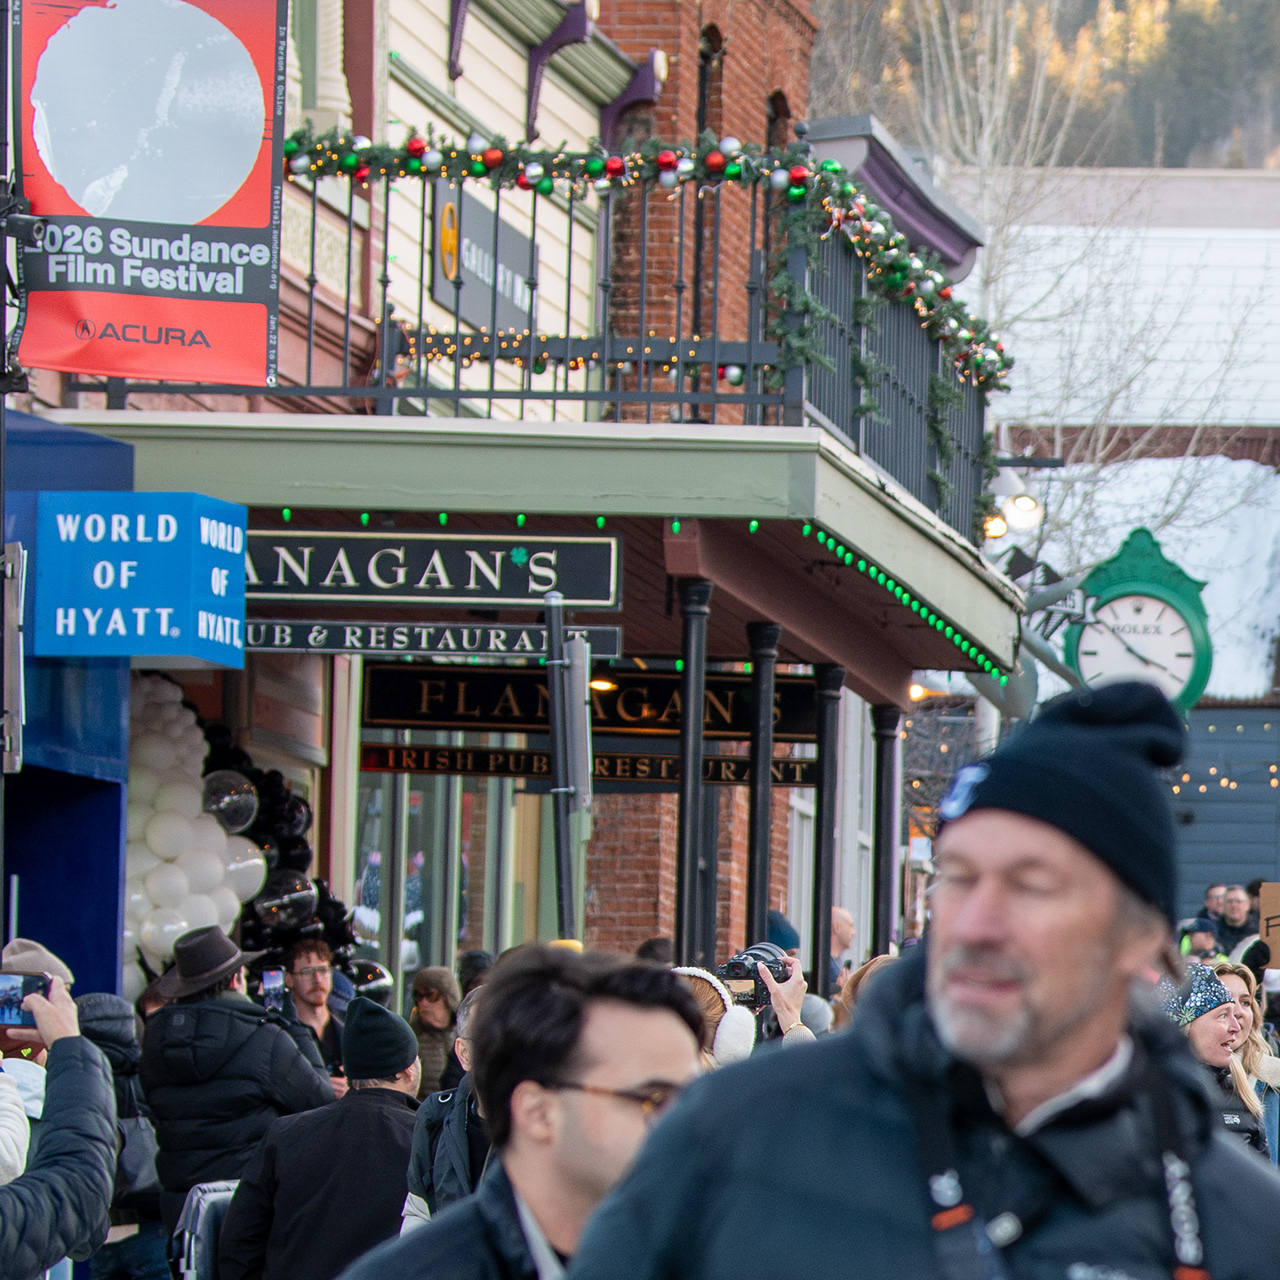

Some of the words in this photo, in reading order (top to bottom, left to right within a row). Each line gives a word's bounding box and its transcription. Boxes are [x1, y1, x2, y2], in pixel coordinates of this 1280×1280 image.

[277, 40, 286, 71] Person
[276, 84, 285, 116] Online
[109, 228, 271, 266] Sundance
[48, 253, 117, 285] Film
[122, 258, 244, 295] Festival
[462, 237, 513, 299] GALLRY
[98, 322, 212, 348] ACURA
[56, 514, 178, 543] WORLD
[200, 516, 244, 555] WORLD
[93, 560, 138, 590] OF
[211, 567, 230, 598] OF
[307, 624, 329, 647] &
[344, 625, 588, 653] RESTAURA
[1110, 623, 1164, 636] ROLEX
[387, 747, 474, 772] IRISH
[488, 752, 549, 774] PUB
[594, 756, 809, 783] RESTRNT
